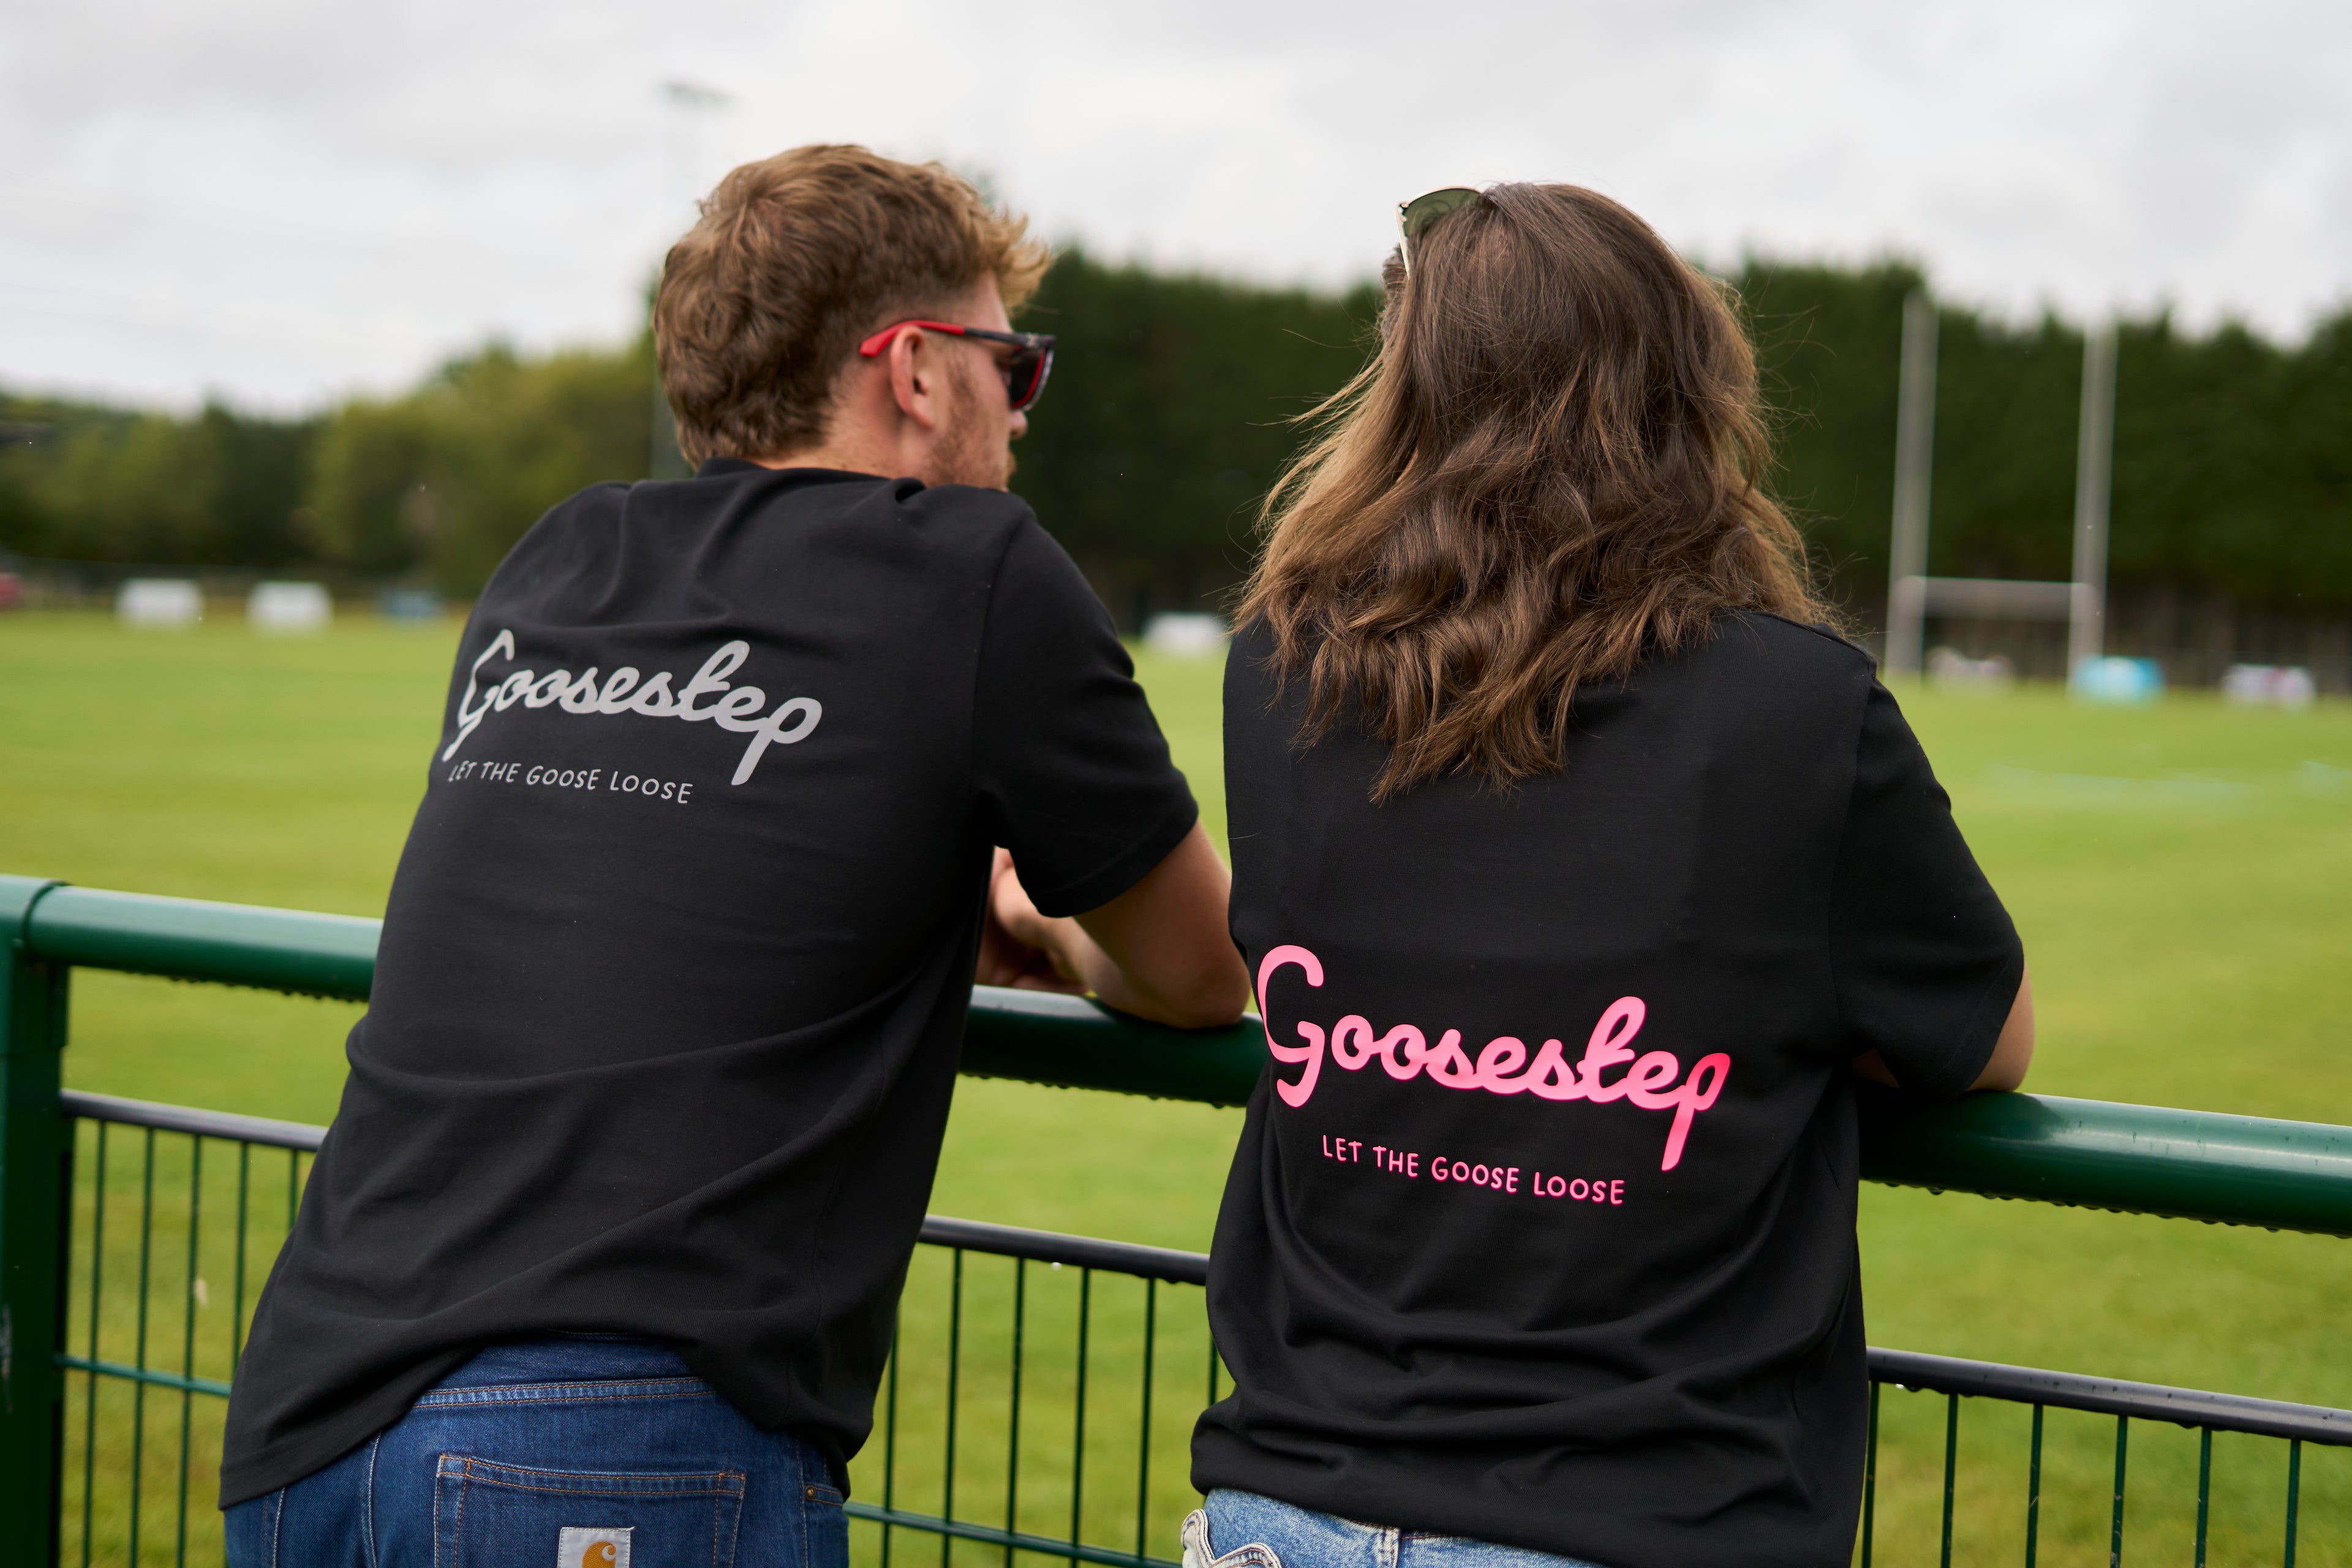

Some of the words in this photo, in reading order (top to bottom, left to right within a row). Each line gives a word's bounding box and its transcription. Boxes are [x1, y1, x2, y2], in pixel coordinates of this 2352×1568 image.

[442, 629, 822, 785] Goosestep
[448, 761, 477, 783] LET
[481, 762, 521, 783] THE
[526, 765, 601, 790] GOOSE
[610, 771, 693, 804] LOOSE
[1257, 944, 1730, 1171] Goosestep
[1322, 1134, 1362, 1163] LET
[1373, 1145, 1419, 1178] THE
[1431, 1157, 1520, 1194] GOOSE
[1534, 1171, 1626, 1205] LOOSE
